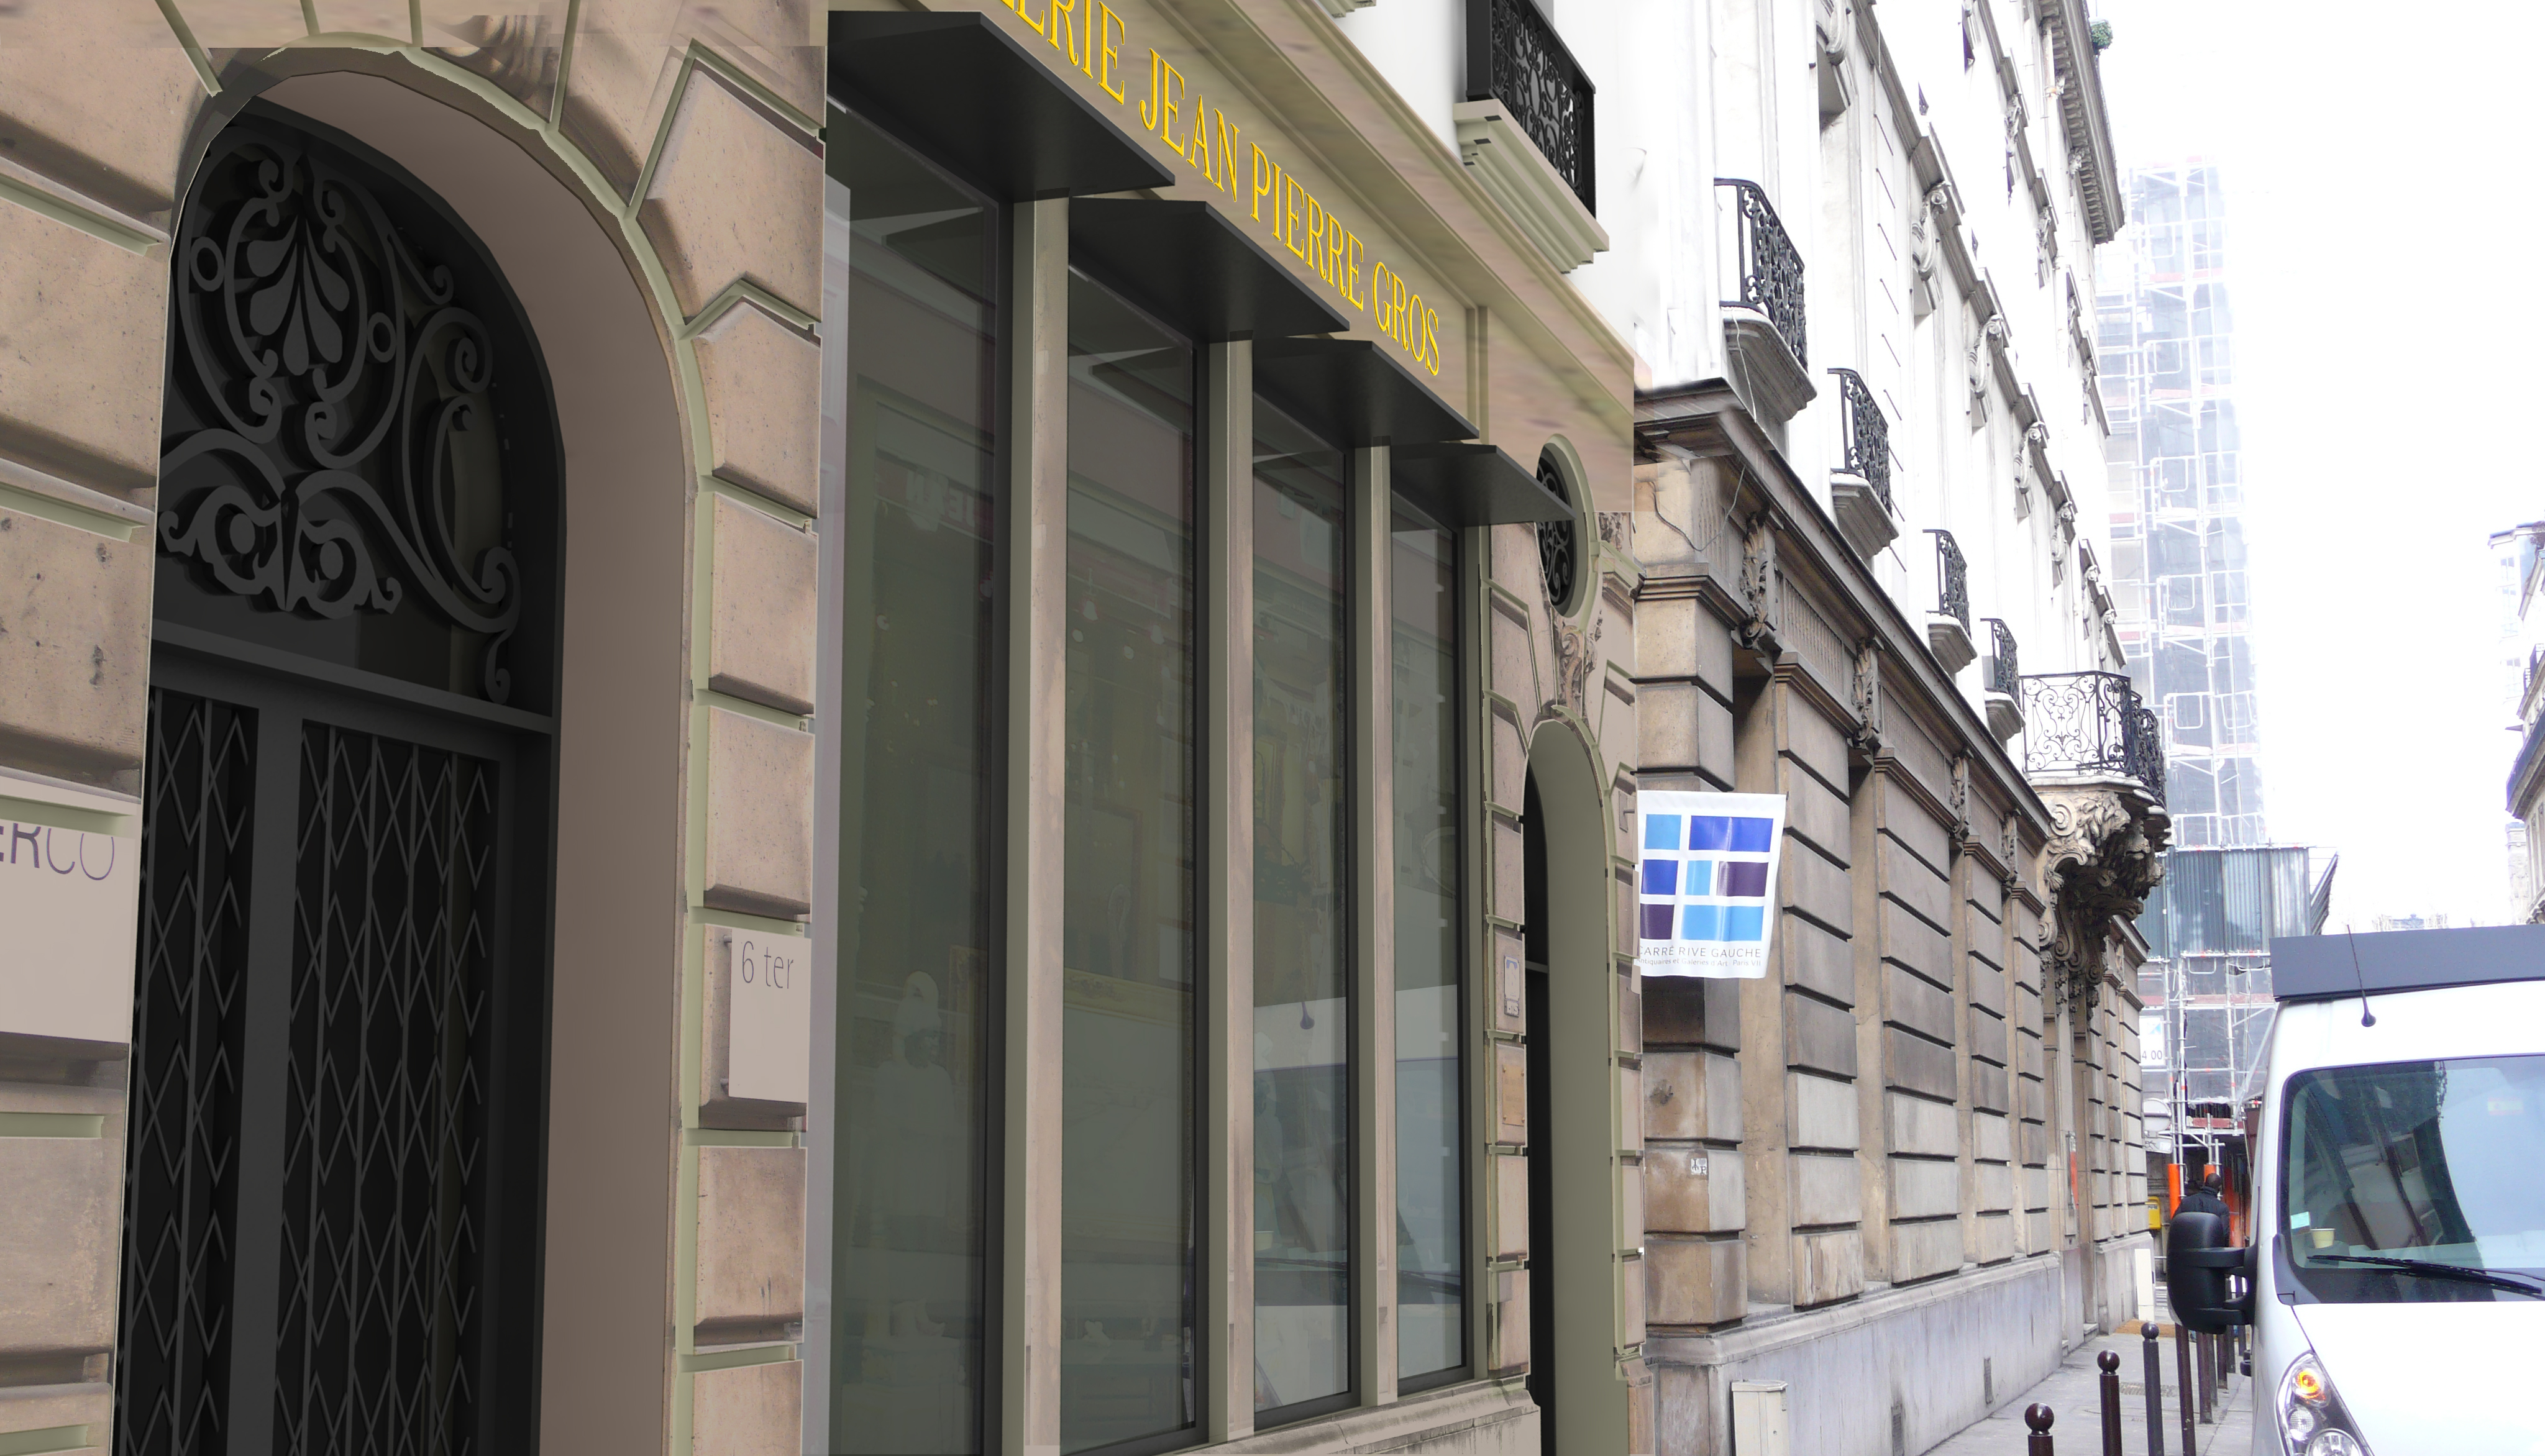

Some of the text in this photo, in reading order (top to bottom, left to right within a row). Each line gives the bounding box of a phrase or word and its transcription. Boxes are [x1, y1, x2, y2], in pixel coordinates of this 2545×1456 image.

[1139, 48, 1240, 202] JEAN
[1250, 142, 1364, 311] PIERRE
[1372, 262, 1440, 376] GROS
[0, 823, 114, 881] RCO
[742, 940, 794, 990] 6 ter
[1679, 947, 1706, 957] RIVE
[1711, 948, 1761, 958] GAUCHE
